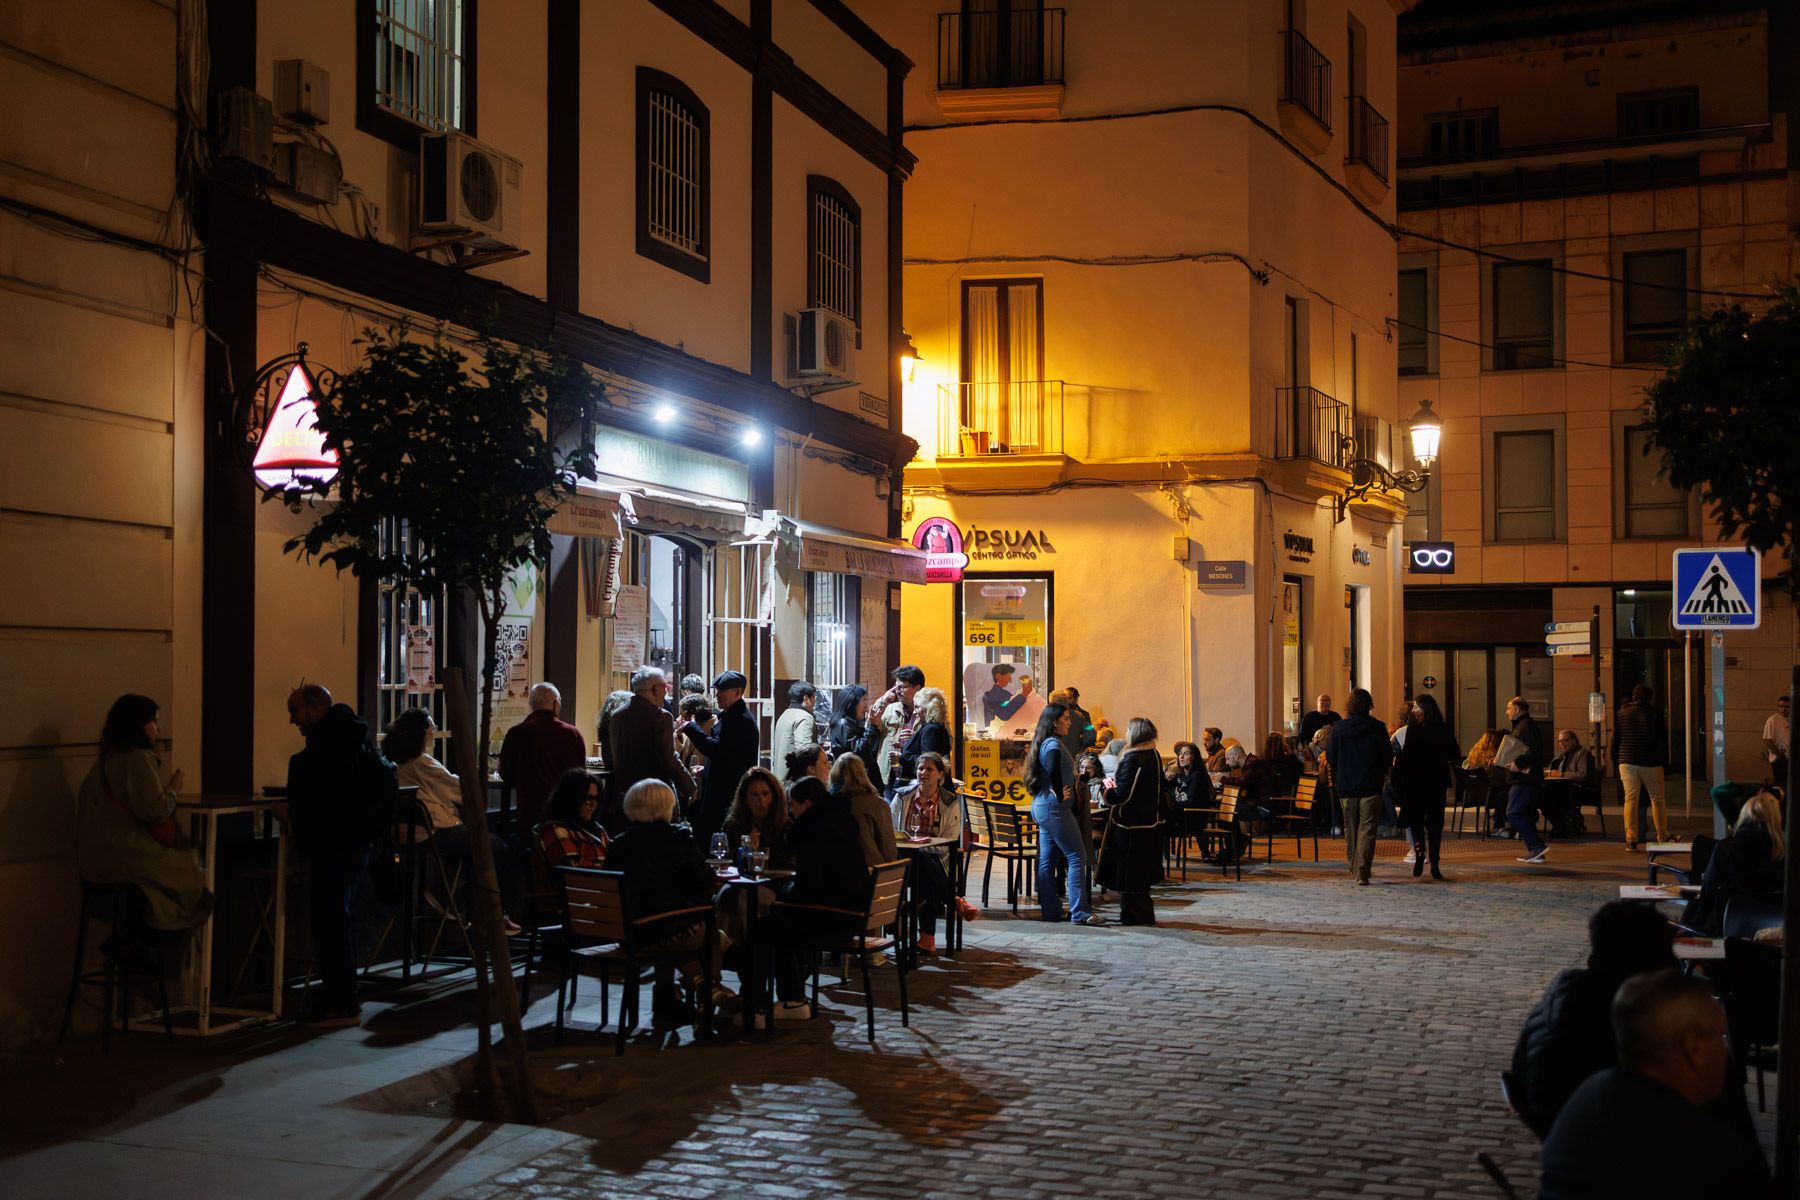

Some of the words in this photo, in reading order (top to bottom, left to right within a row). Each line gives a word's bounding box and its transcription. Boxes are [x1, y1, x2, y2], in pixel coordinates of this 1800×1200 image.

[971, 551, 1004, 561] CENTRO
[926, 557, 963, 567] zcampo
[602, 542, 624, 601] Cruzcamp
[970, 633, 995, 643] 69€
[971, 766, 989, 777] 2x
[971, 780, 1026, 801] 69€
